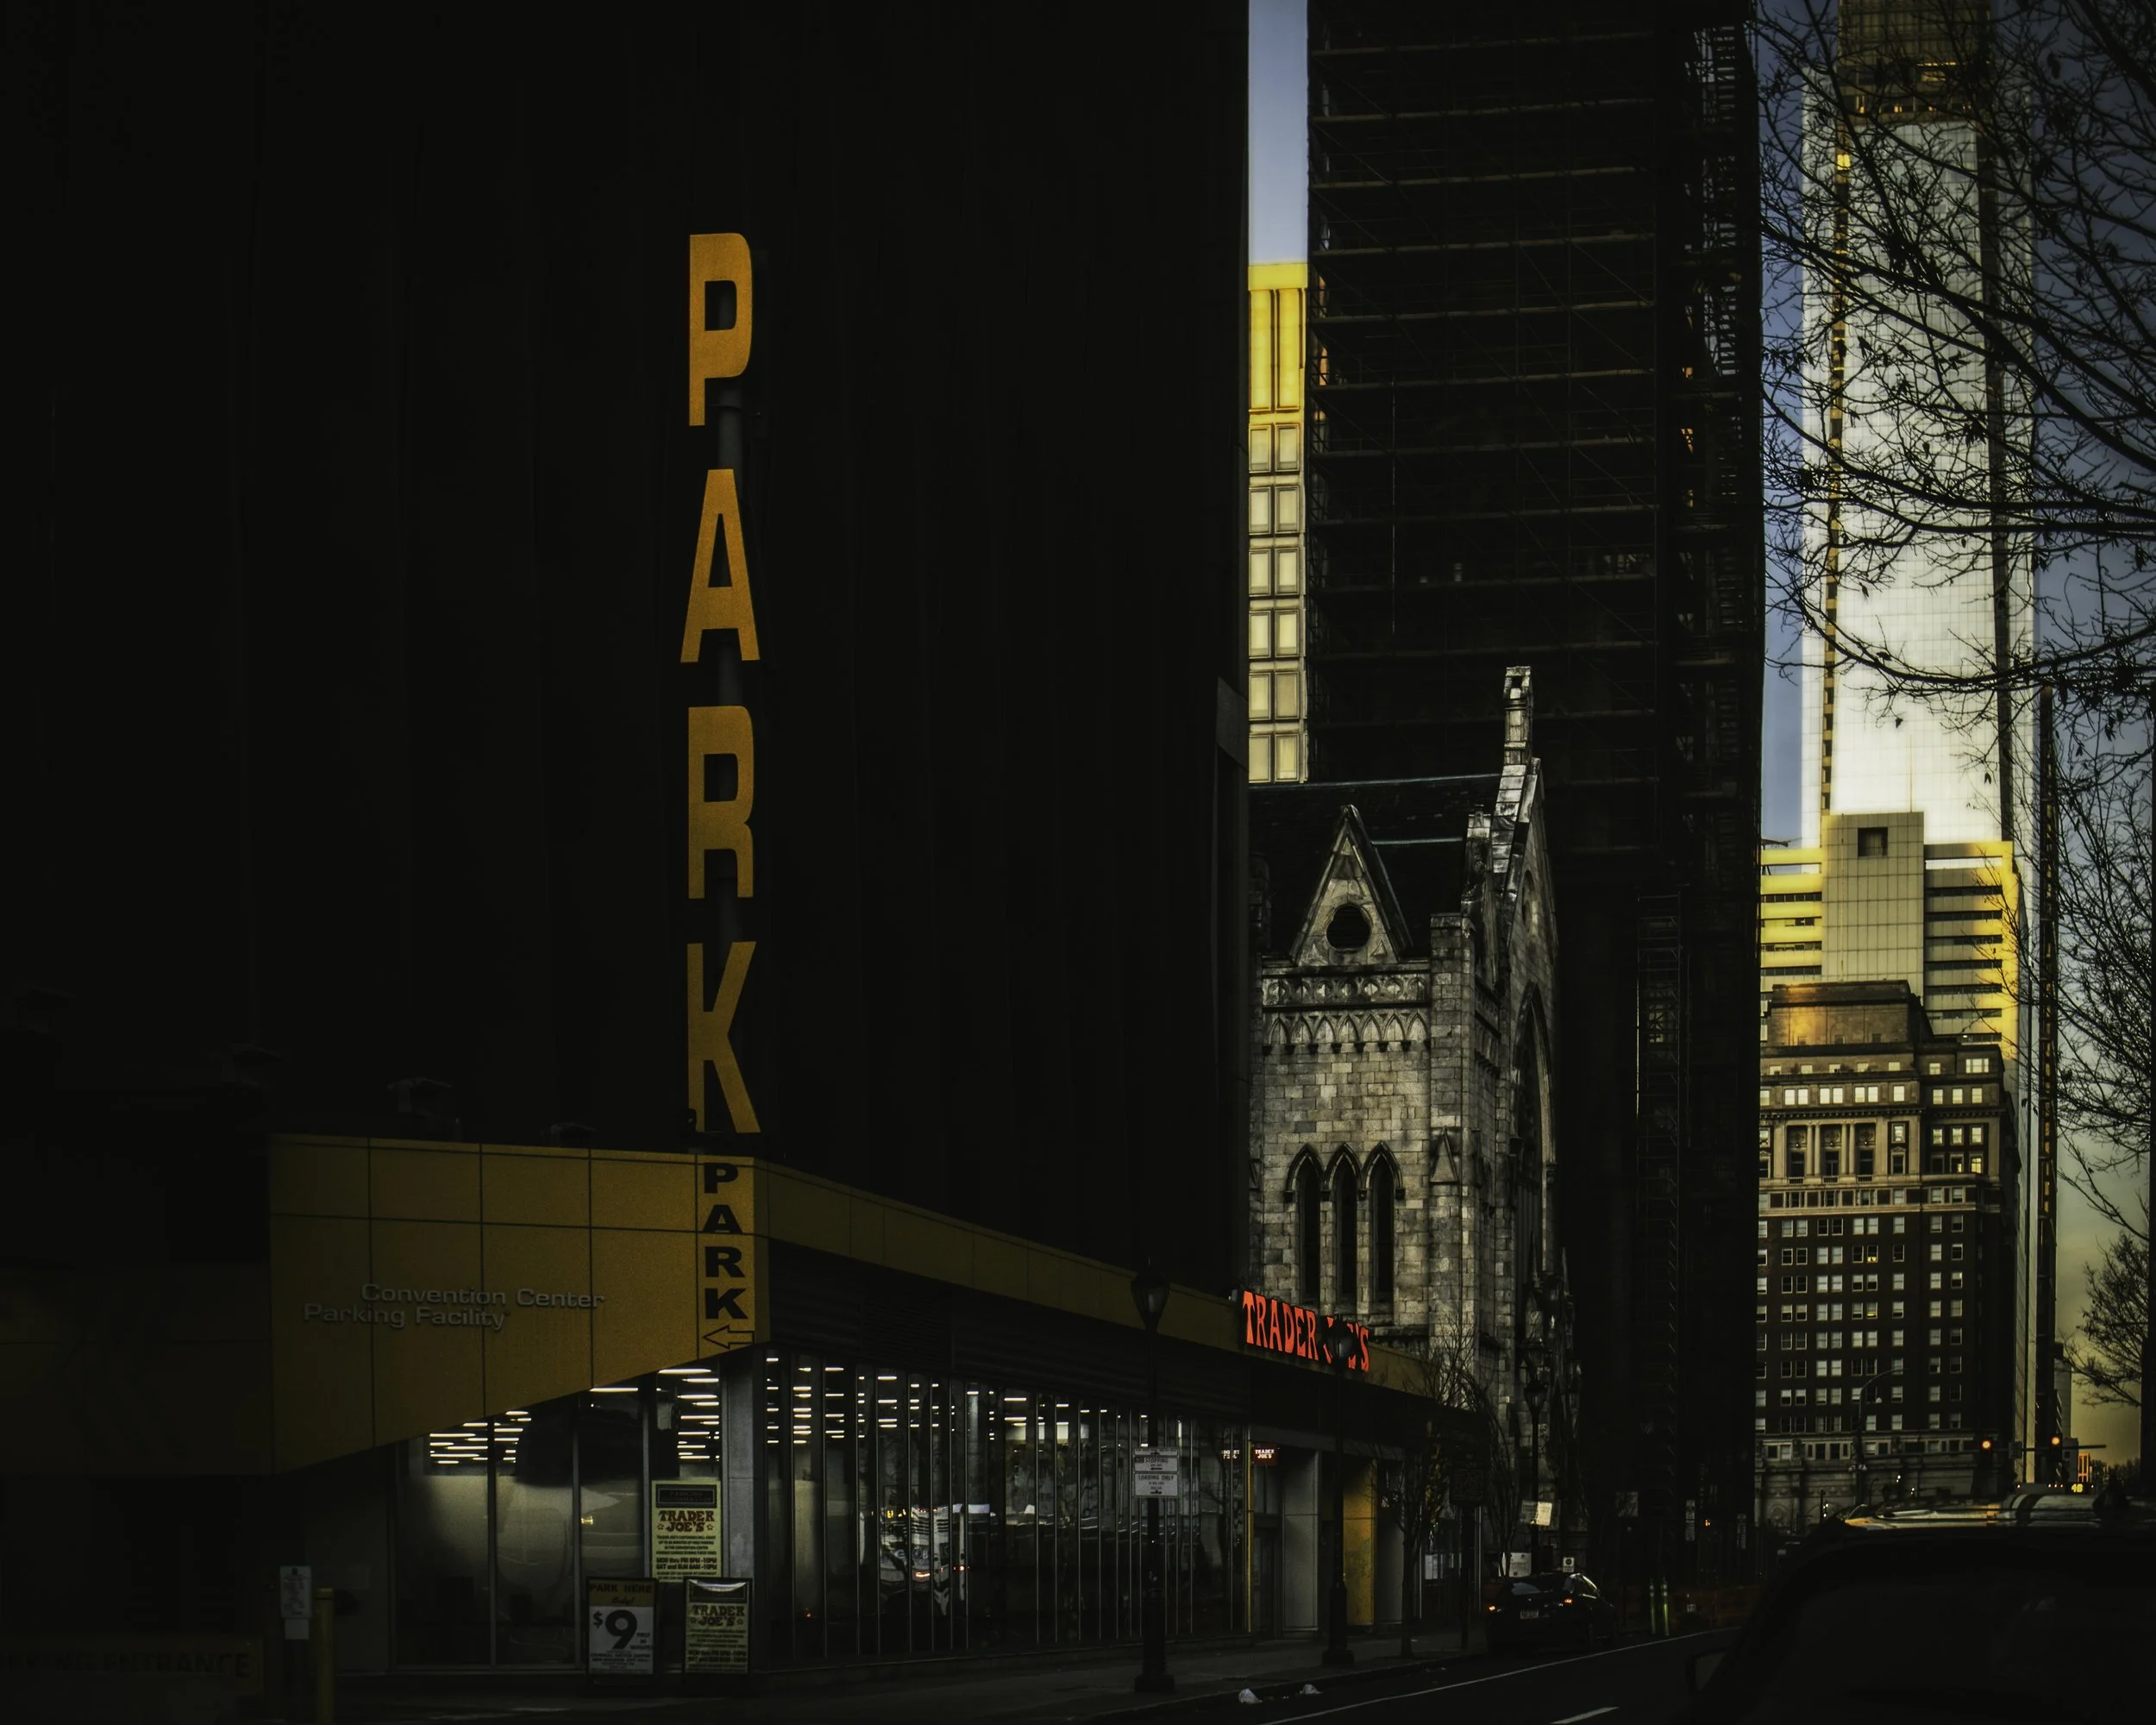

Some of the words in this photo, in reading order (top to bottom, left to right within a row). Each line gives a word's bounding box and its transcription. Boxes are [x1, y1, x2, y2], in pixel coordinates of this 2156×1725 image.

[680, 232, 761, 1133] PARK
[703, 1163, 748, 1319] PARK
[360, 1283, 506, 1304] Convention
[517, 1289, 605, 1308] Center
[304, 1303, 405, 1329] Parking
[416, 1306, 509, 1331] Facility
[1242, 1290, 1319, 1361] TRADER
[659, 1510, 715, 1521] TRADER
[666, 1521, 705, 1532] JOE'S
[590, 1584, 617, 1592] PARK
[624, 1584, 652, 1593] HERE
[692, 1605, 745, 1616] TRADER
[698, 1615, 736, 1627] JOE'S
[103, 1652, 250, 1678] ENTRANCE
